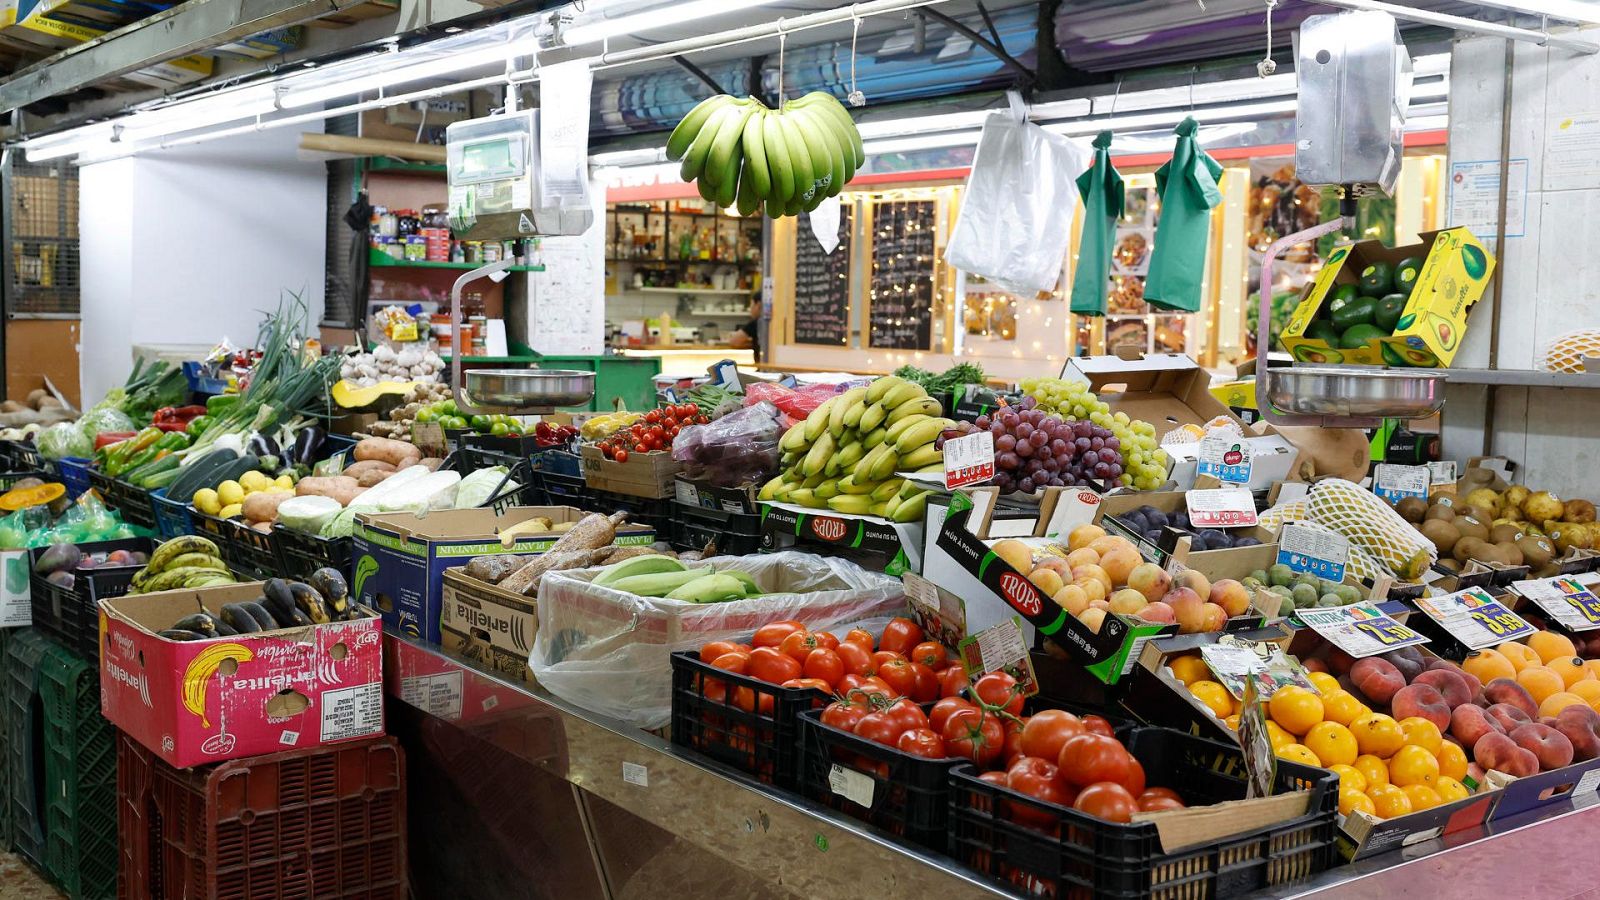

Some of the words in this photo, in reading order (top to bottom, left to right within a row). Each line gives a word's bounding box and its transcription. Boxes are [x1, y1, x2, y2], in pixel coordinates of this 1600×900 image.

[1078, 492, 1100, 504] TROPS
[814, 518, 846, 538] TROPS
[865, 531, 883, 539] PUNTO
[882, 532, 890, 540] SU
[439, 544, 488, 555] PLANTAIN
[944, 529, 958, 543] MÛR
[961, 542, 979, 560] POINT
[1001, 574, 1041, 615] TROPS
[1304, 611, 1346, 626] FRUTAS
[1471, 611, 1525, 635] 3,99
[1357, 623, 1416, 645] 2,50
